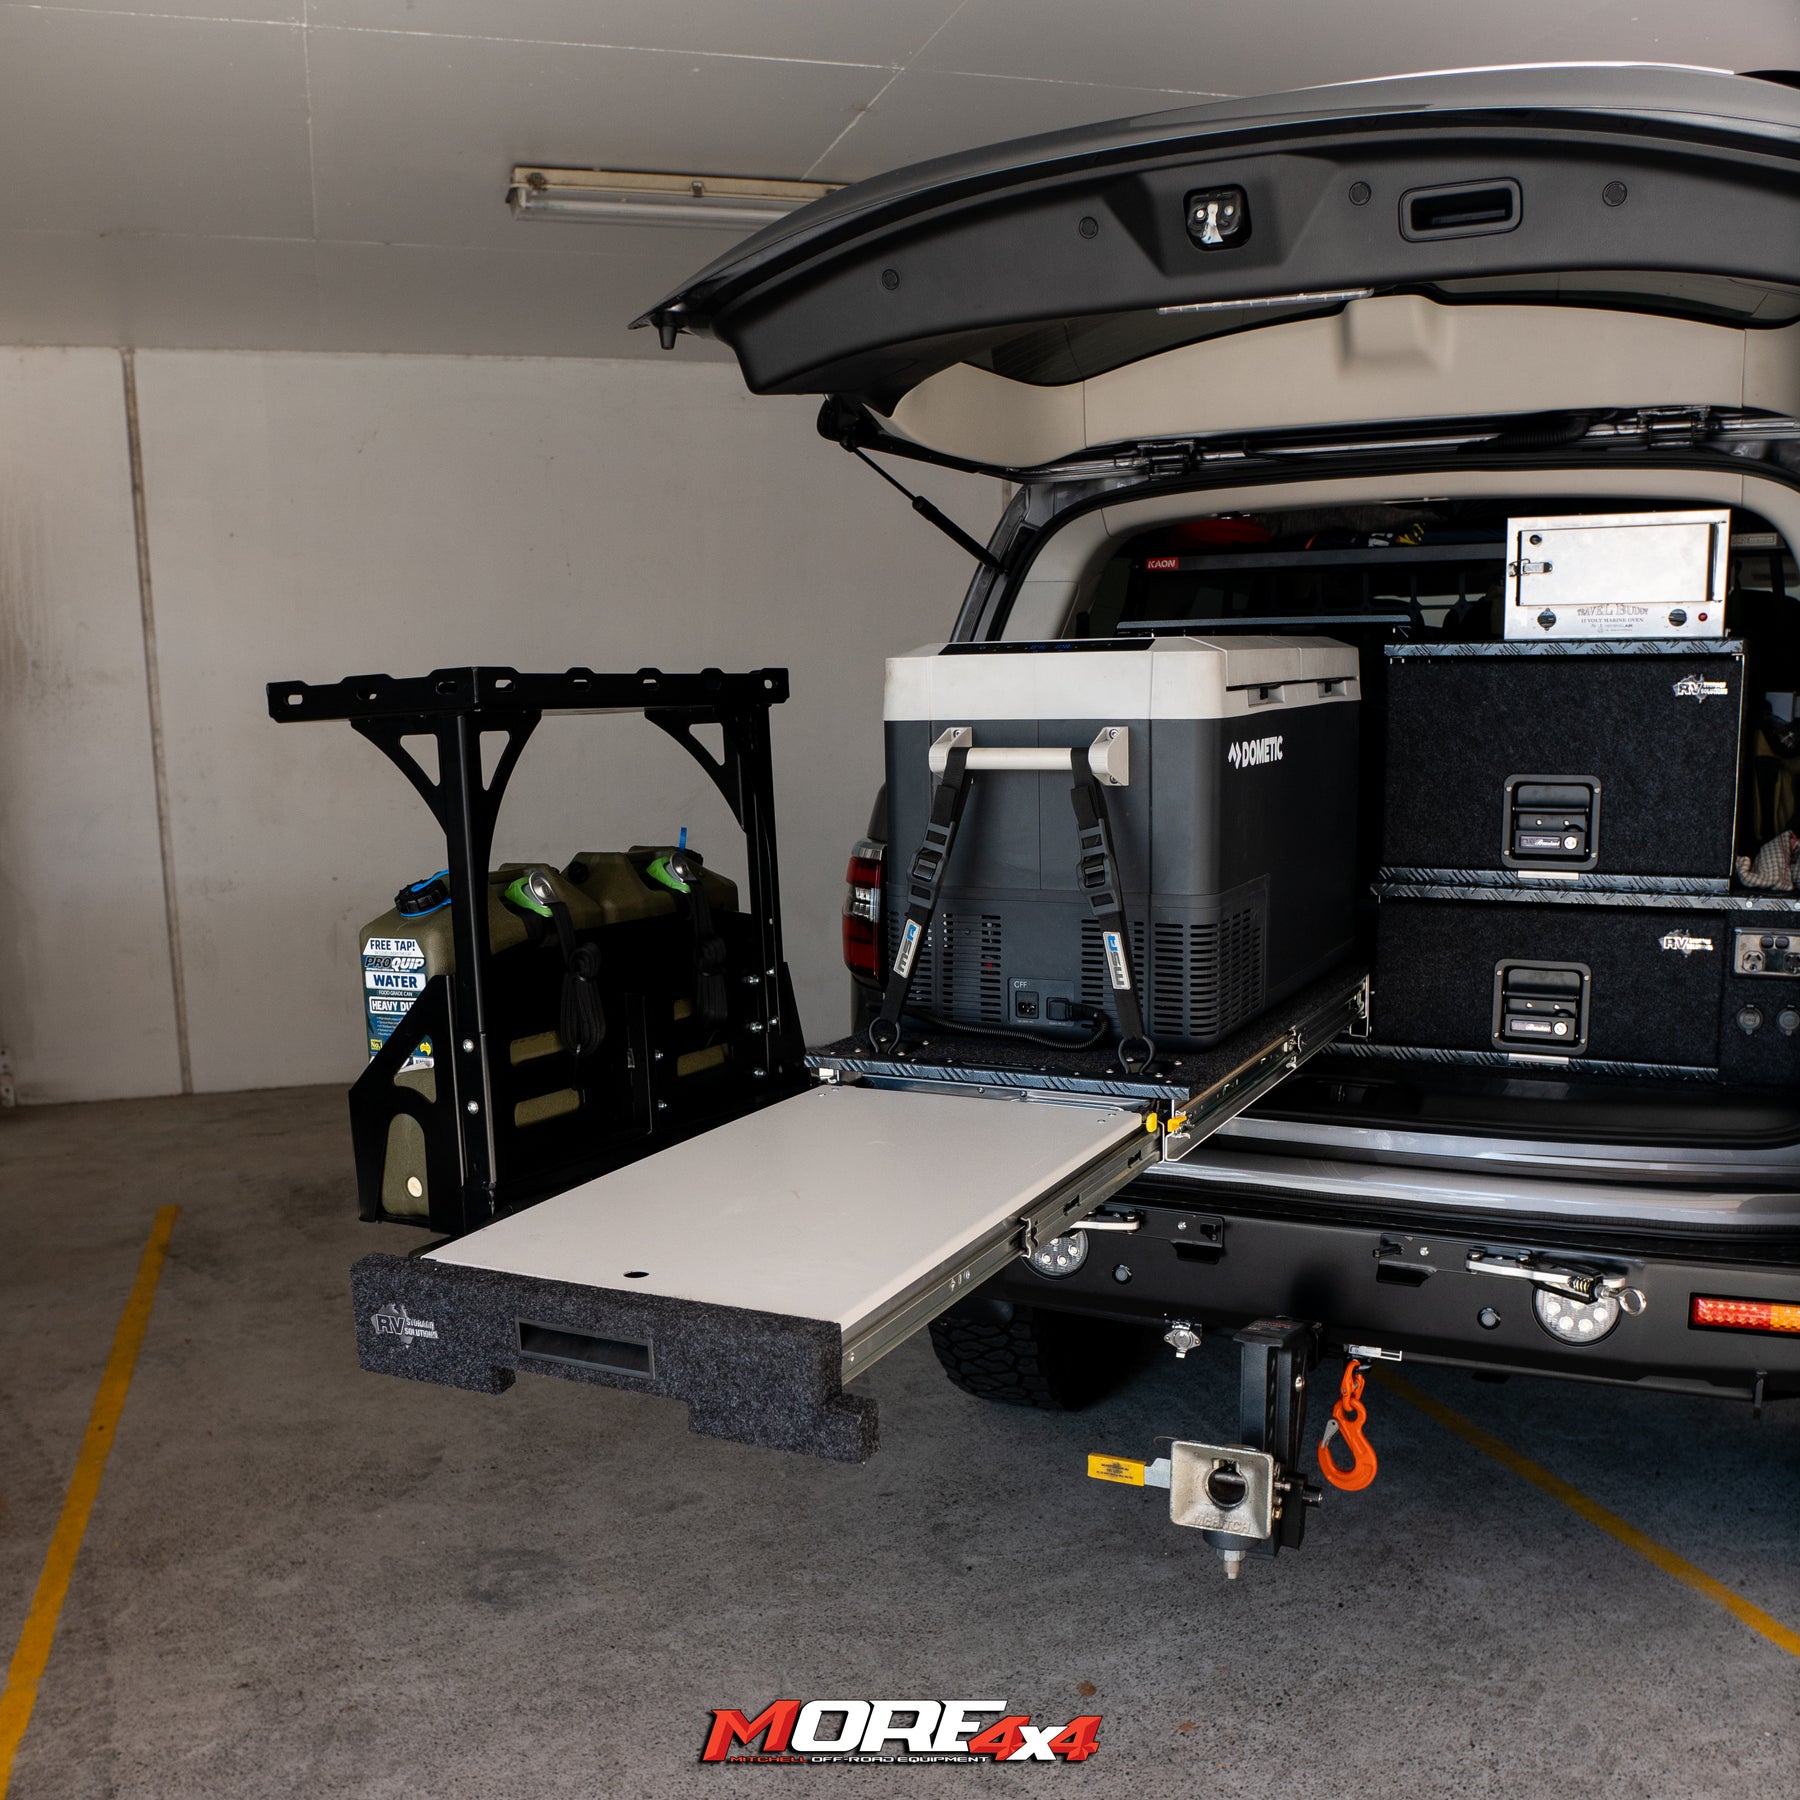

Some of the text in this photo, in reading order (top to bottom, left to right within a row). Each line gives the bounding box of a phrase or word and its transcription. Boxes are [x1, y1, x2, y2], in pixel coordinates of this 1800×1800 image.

[1147, 560, 1176, 569] KAON
[1677, 681, 1702, 696] RV
[1242, 735, 1283, 768] DOMETIC
[370, 939, 416, 951] FREE TAP!
[1663, 936, 1689, 950] RV
[365, 956, 425, 972] PROQUIP
[373, 974, 418, 988] WATER
[1013, 980, 1028, 989] CFF
[371, 1000, 399, 1011] HEAVY
[375, 1313, 405, 1336] RV
